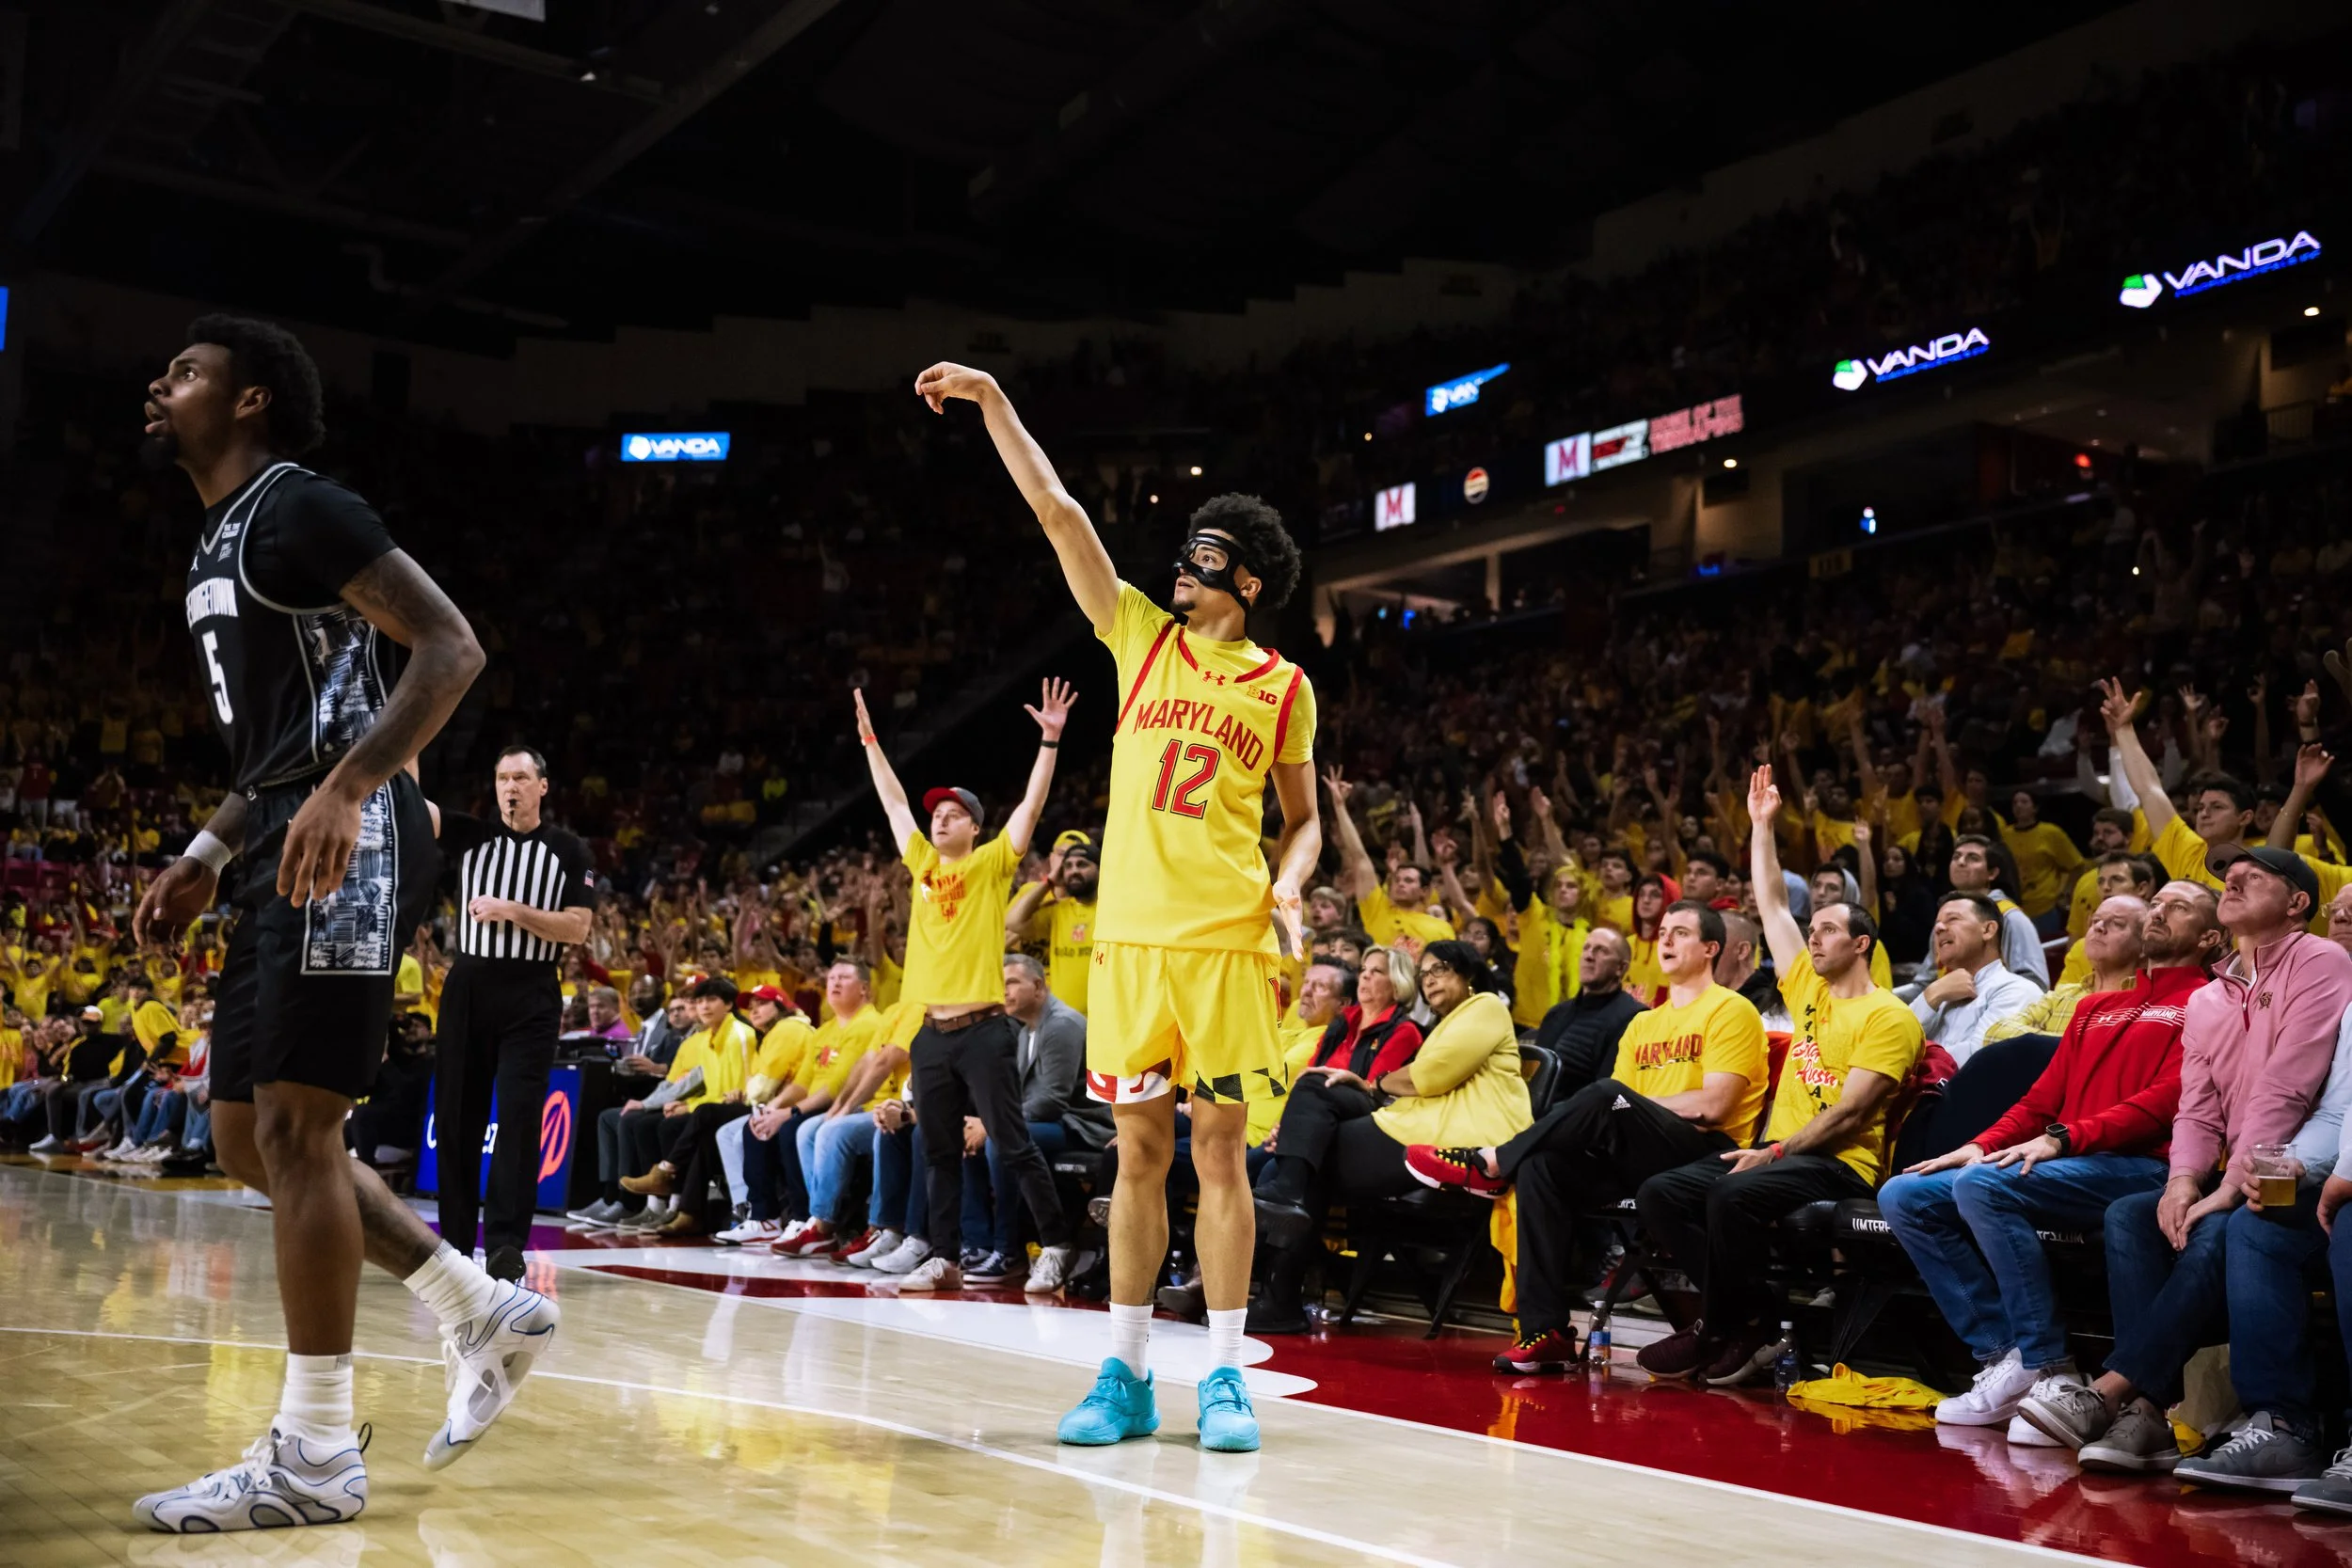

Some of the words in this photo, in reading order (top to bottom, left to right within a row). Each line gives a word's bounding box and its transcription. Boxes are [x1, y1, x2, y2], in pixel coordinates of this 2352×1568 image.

[2163, 230, 2321, 291] VANDA
[1867, 326, 1991, 375] VANDA
[648, 436, 721, 455] VANDA
[1558, 438, 1579, 481] M
[1385, 486, 1403, 526] M
[201, 628, 234, 725] 5
[1133, 698, 1264, 771] MARYLAND
[1152, 738, 1221, 820] 12
[2140, 1009, 2177, 1020] MARYLAND
